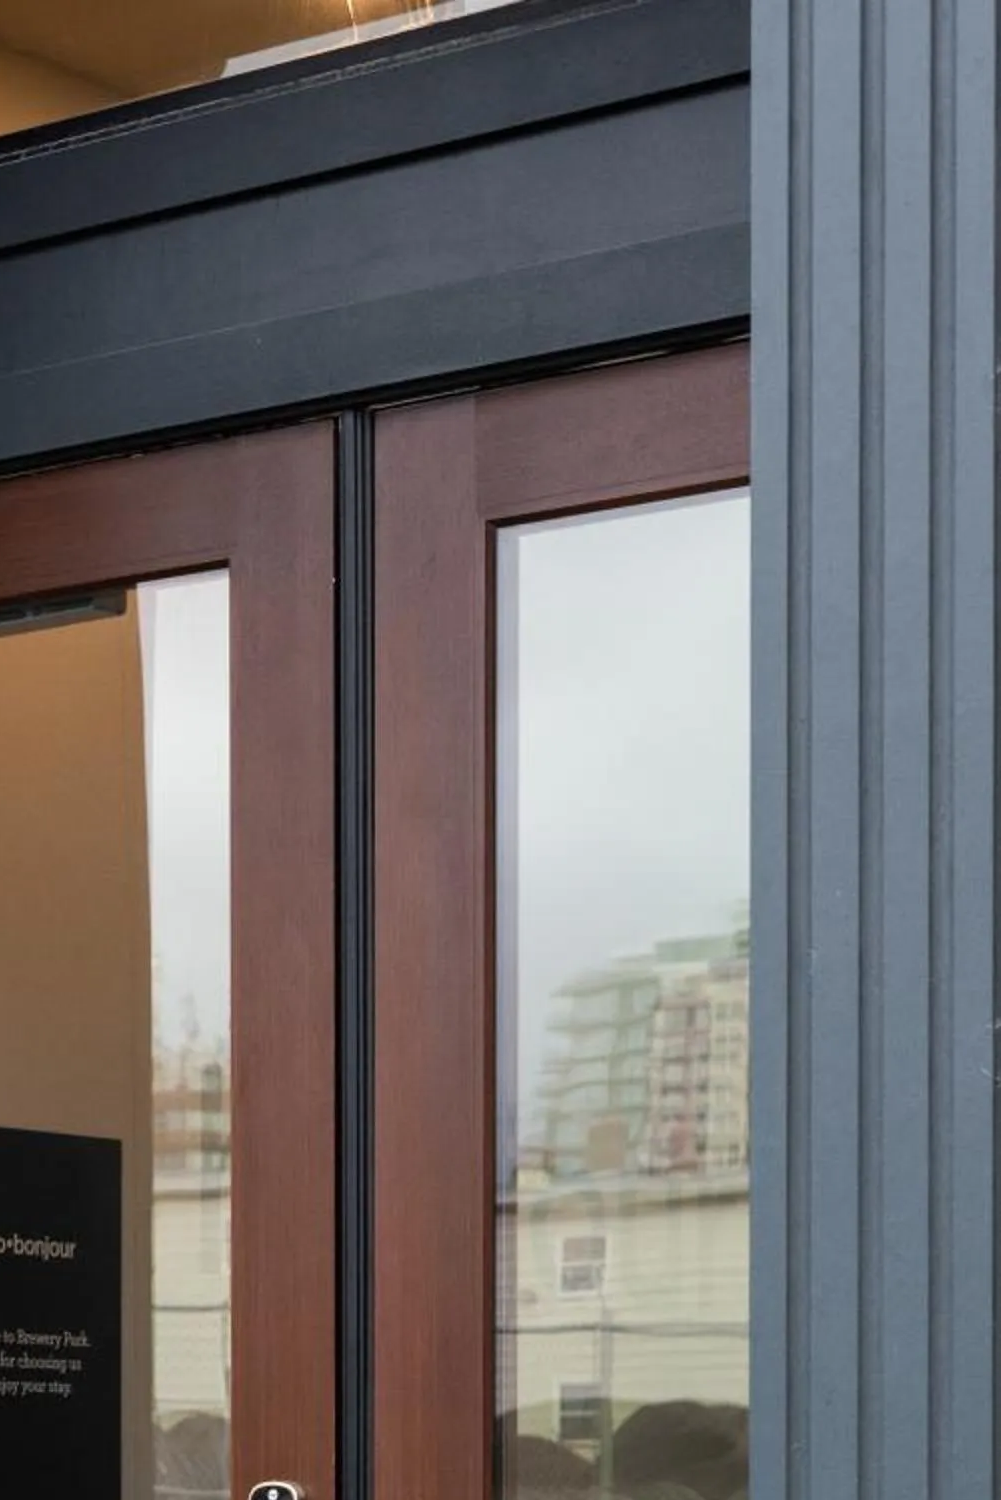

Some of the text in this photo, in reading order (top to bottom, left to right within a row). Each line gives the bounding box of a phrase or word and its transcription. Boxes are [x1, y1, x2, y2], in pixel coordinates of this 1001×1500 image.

[3, 1330, 15, 1344] to
[16, 1328, 63, 1350] Brewery
[0, 1350, 16, 1368] for
[17, 1352, 67, 1374] choosing
[68, 1359, 83, 1371] us
[20, 1381, 48, 1397] your
